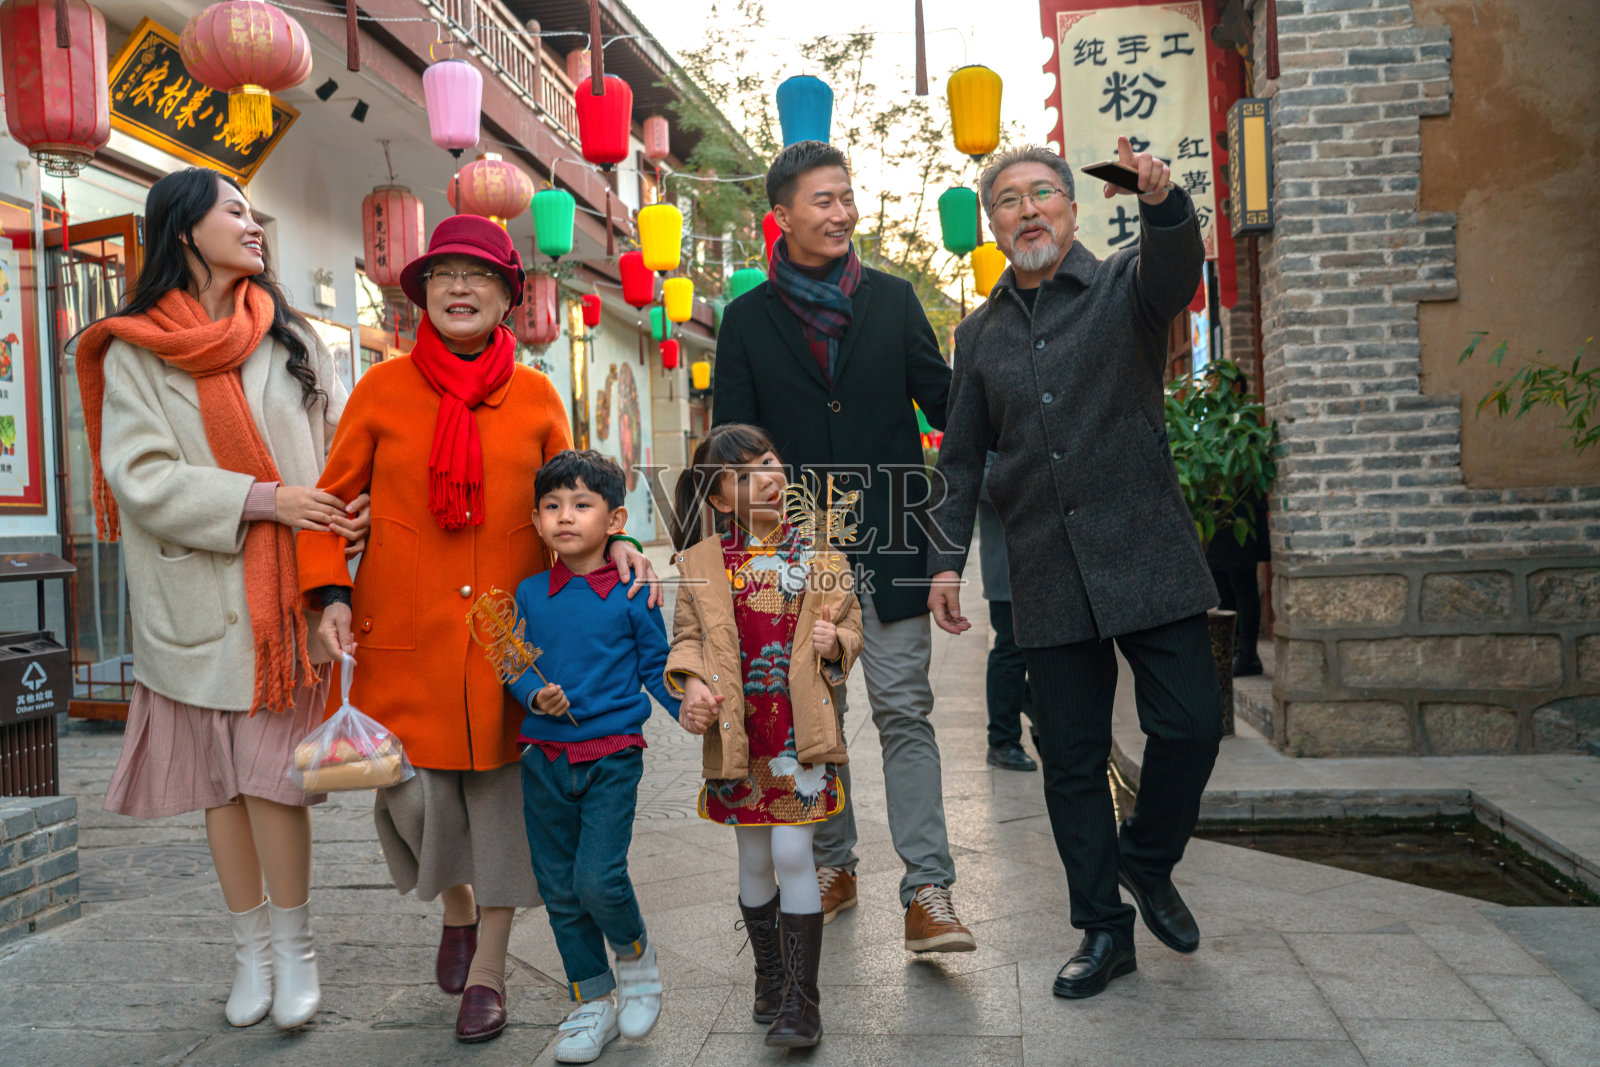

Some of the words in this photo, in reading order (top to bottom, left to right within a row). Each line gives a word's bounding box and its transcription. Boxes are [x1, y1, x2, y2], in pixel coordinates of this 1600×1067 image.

[1073, 33, 1195, 66] 纯手工
[16, 705, 34, 714] Other
